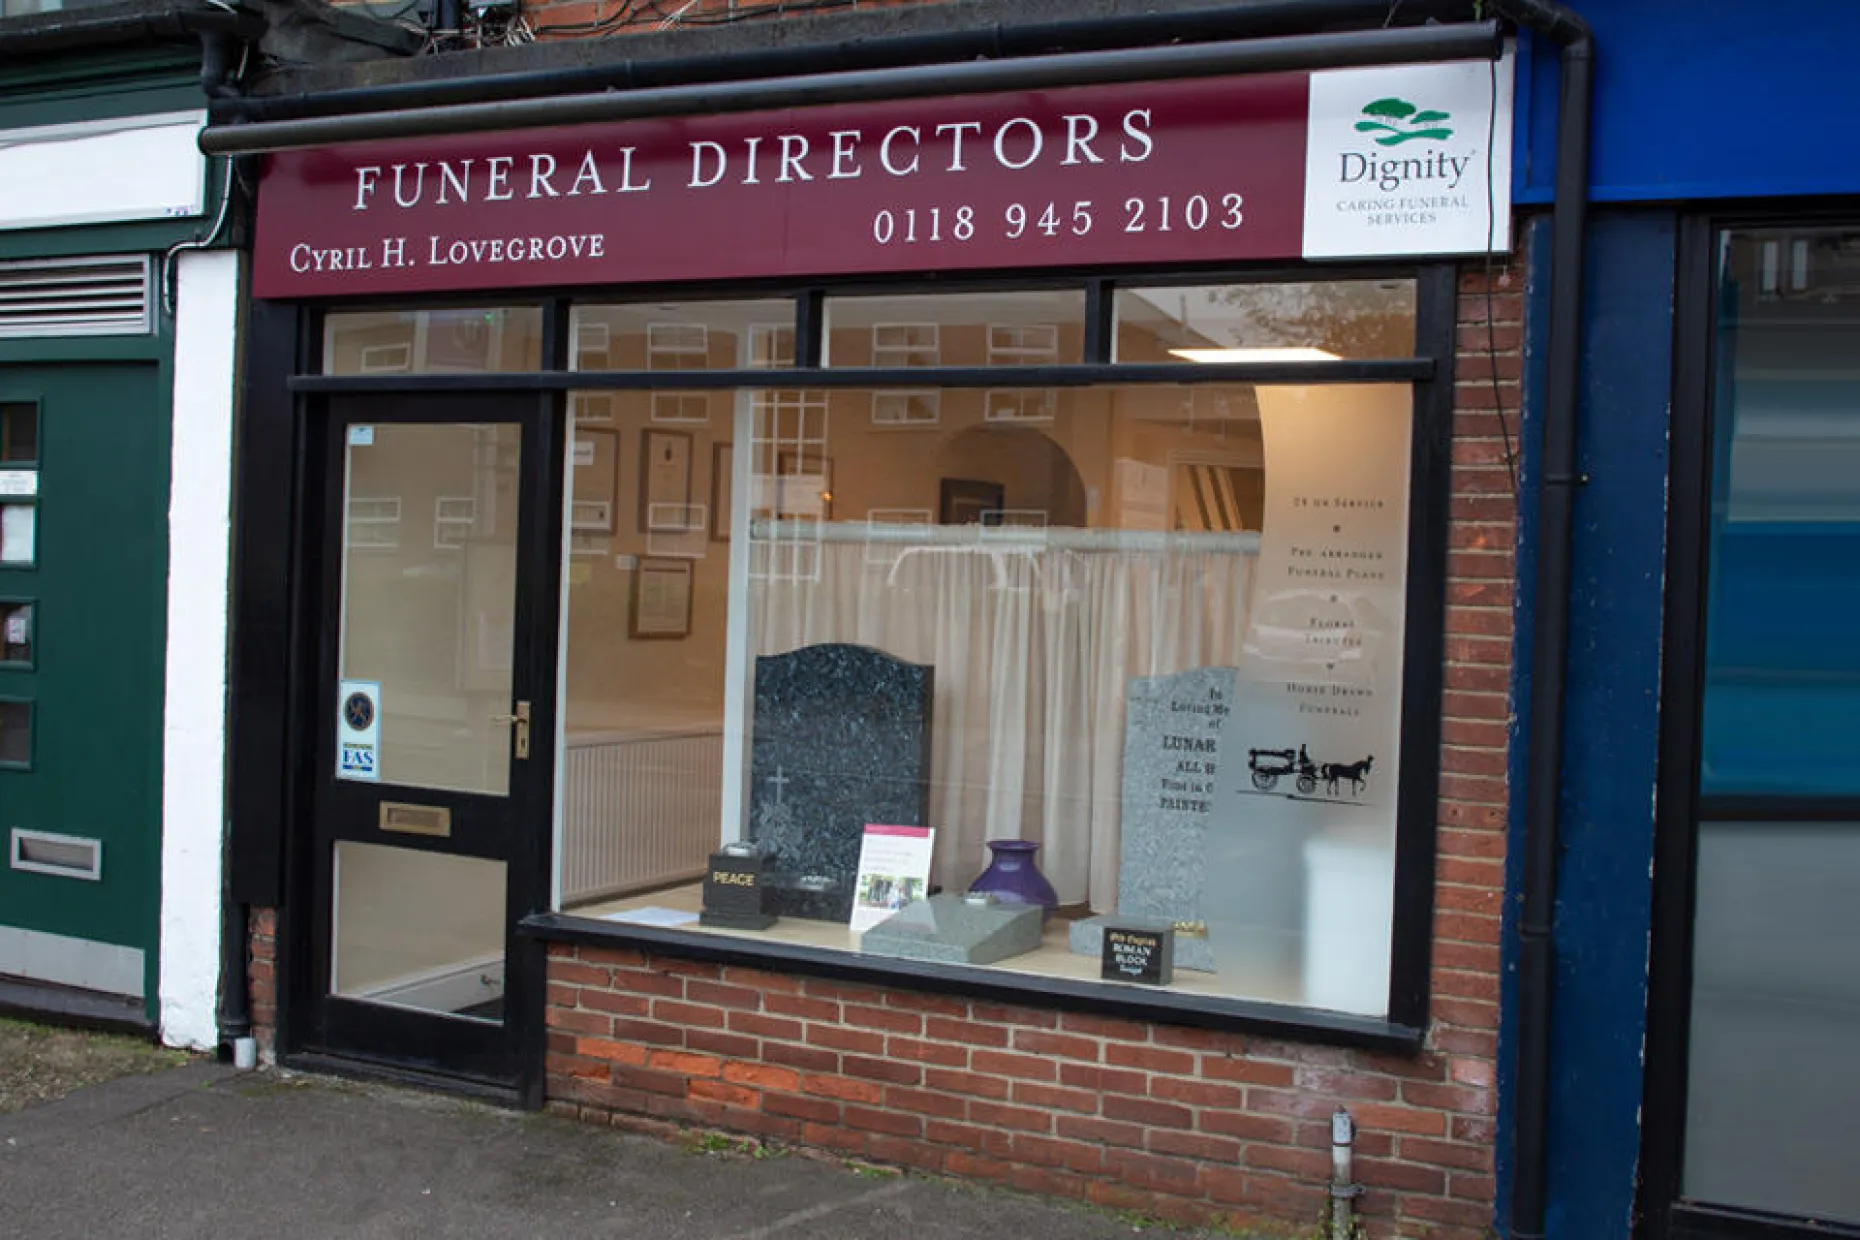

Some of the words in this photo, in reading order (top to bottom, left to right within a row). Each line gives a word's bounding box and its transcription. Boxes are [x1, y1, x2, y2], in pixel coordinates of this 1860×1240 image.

[352, 146, 651, 210] FUNERAL
[687, 109, 1154, 188] DIRECTORS
[1339, 149, 1470, 192] Dignity
[1336, 199, 1395, 213] CARING
[1400, 195, 1468, 209] FUNERAL
[873, 206, 975, 244] 0118
[1005, 201, 1093, 239] 945
[1123, 193, 1244, 234] 2103
[1368, 211, 1436, 226] SERVICES
[290, 243, 372, 273] CYRIL
[380, 238, 415, 268] H.
[428, 234, 605, 266] LOVEGROVE
[1163, 735, 1217, 753] LUNAR
[712, 871, 756, 887] PEACE
